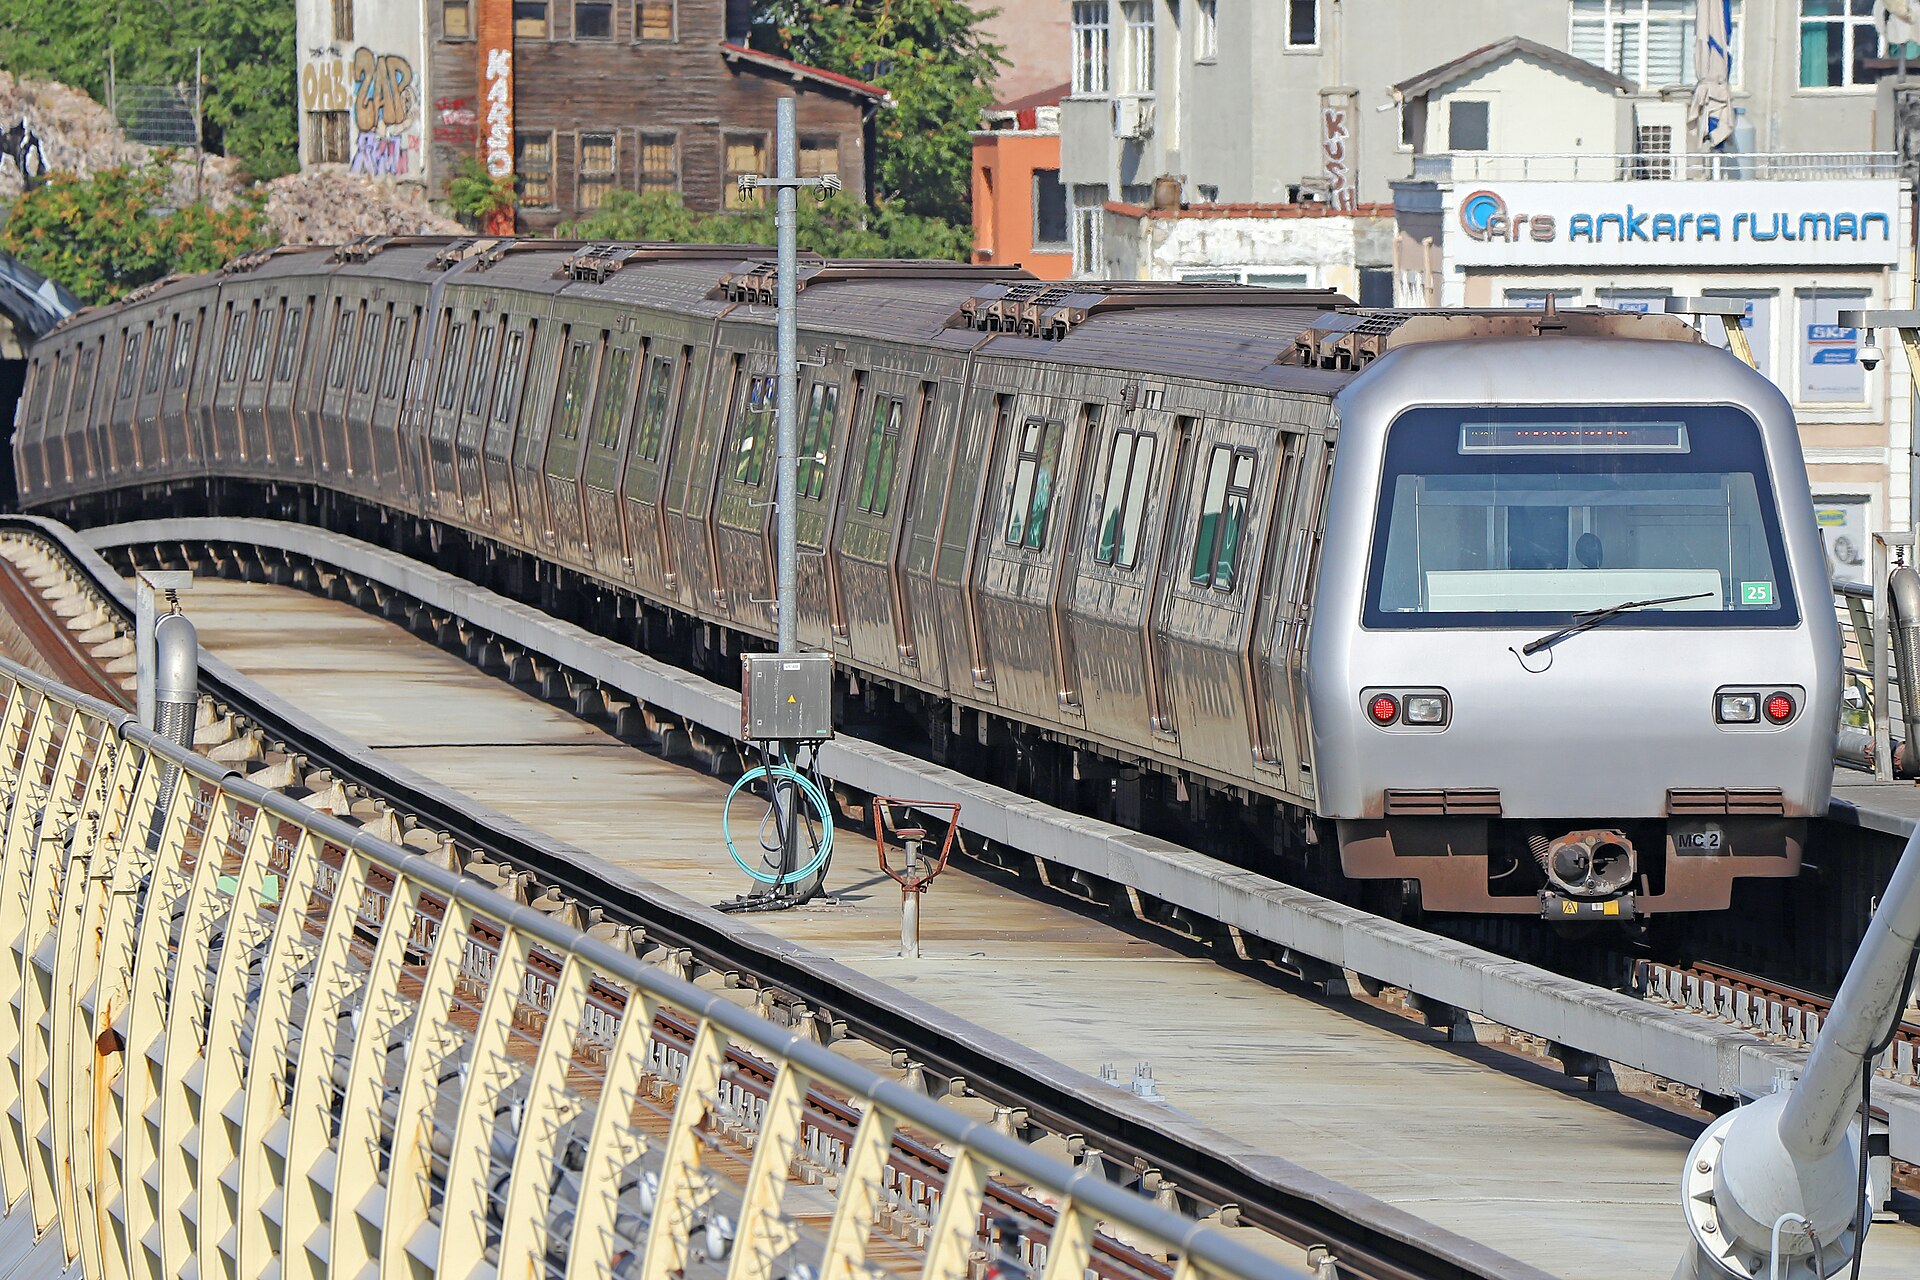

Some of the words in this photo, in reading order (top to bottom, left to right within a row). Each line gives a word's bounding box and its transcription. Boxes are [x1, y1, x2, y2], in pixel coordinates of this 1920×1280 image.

[486, 48, 512, 177] KARSO
[1747, 586, 1767, 600] 25
[1679, 834, 1704, 847] MC
[1709, 833, 1719, 847] 2
